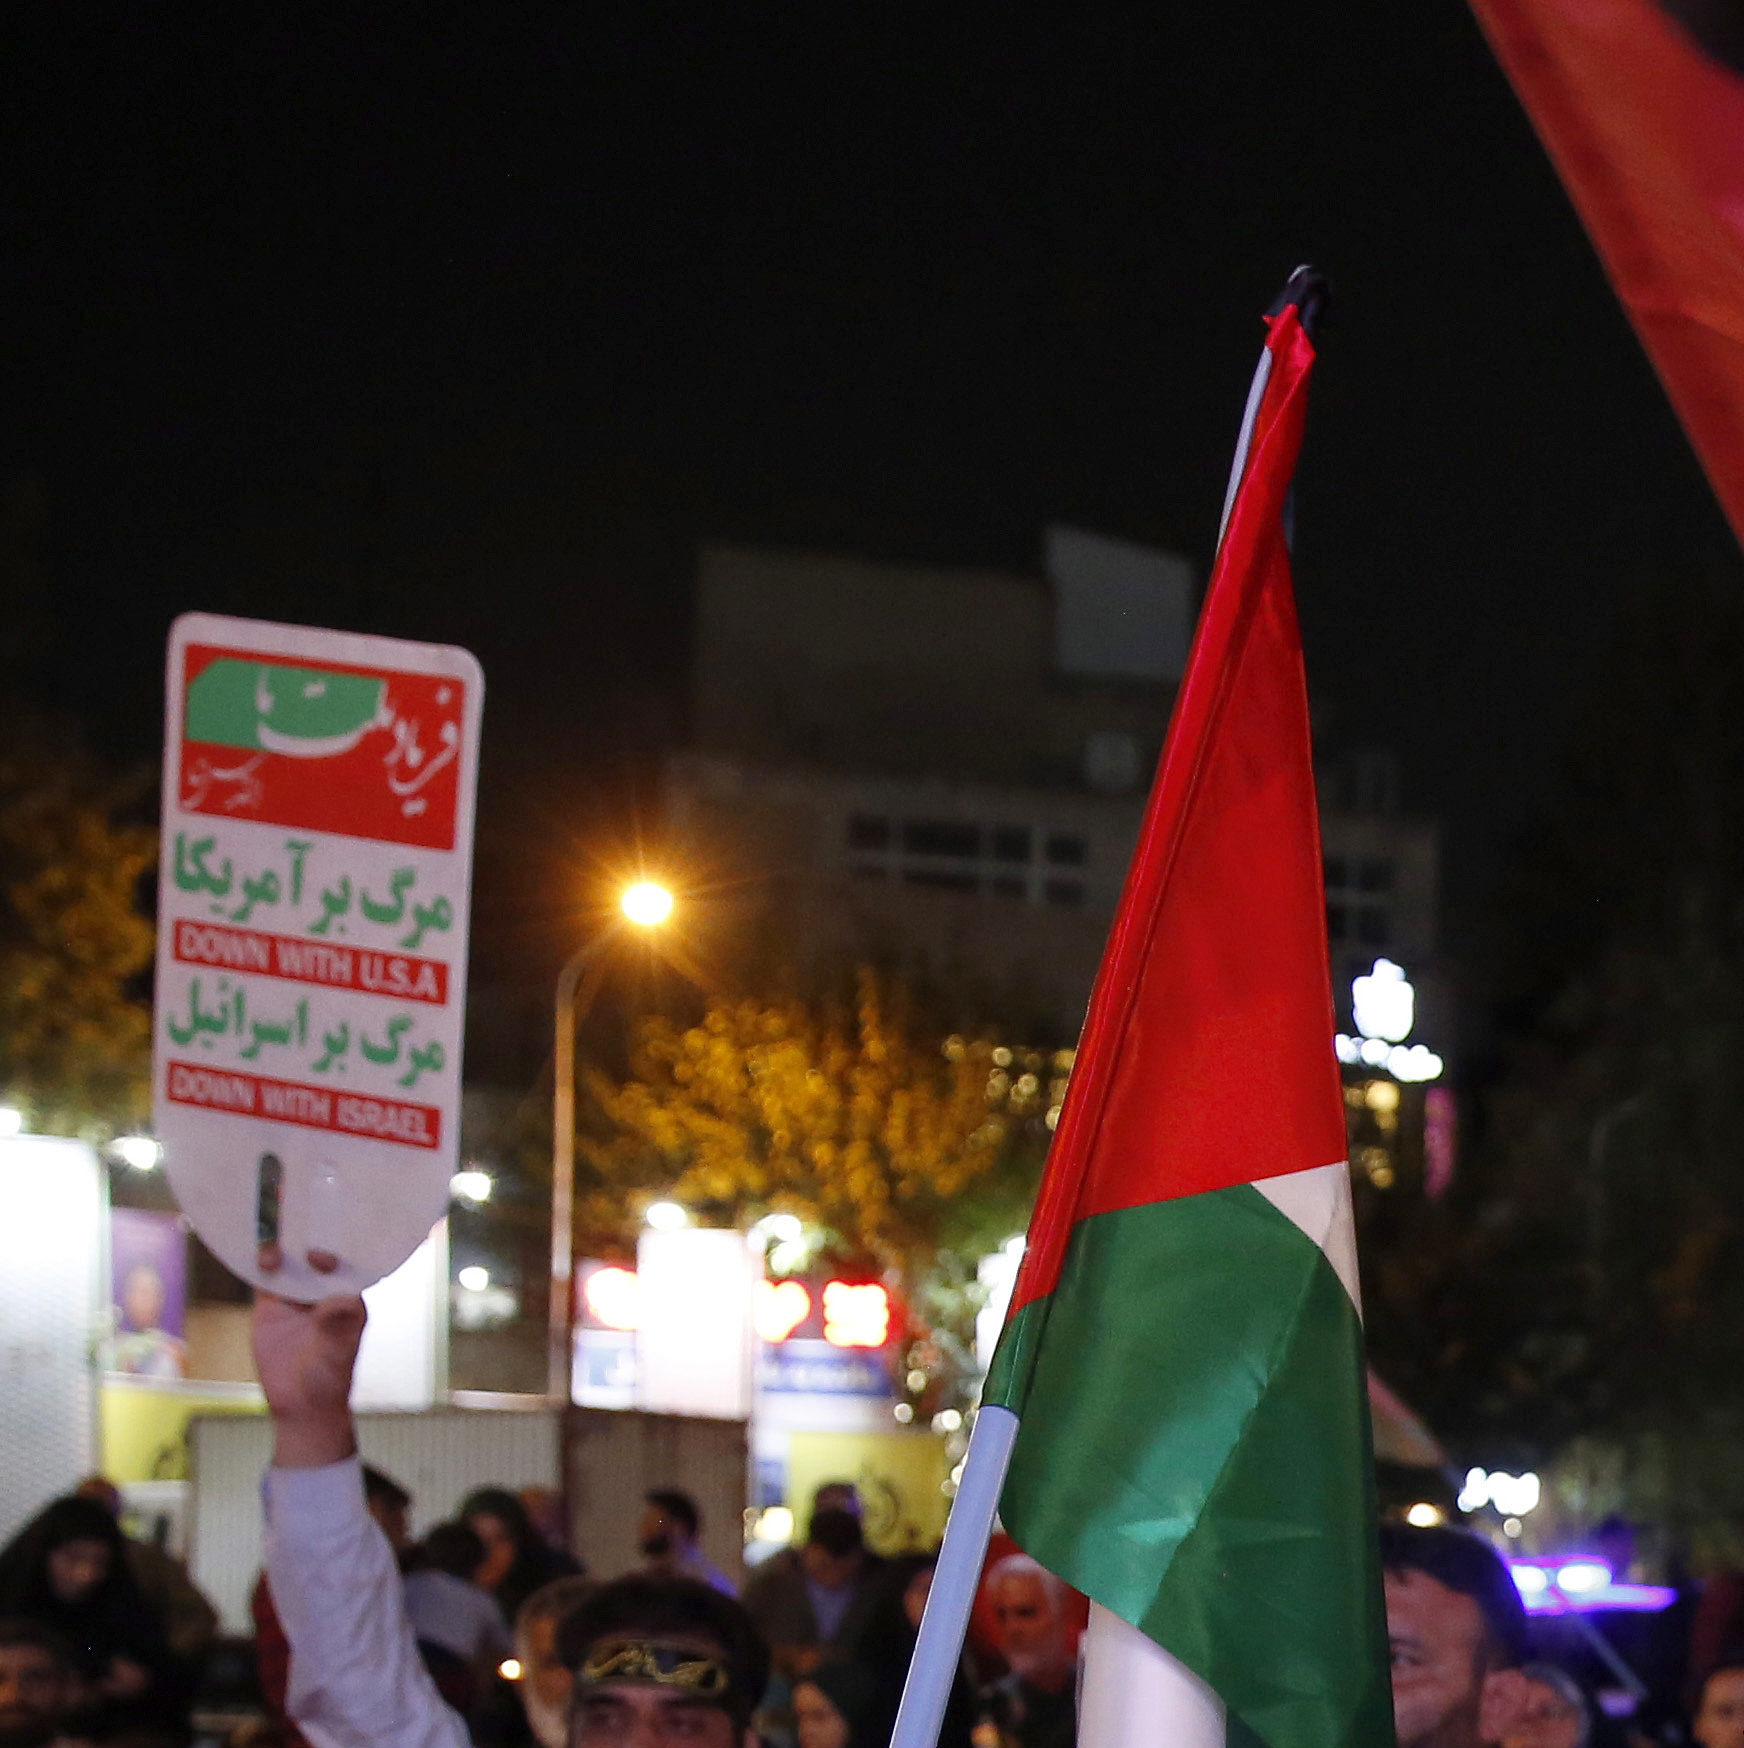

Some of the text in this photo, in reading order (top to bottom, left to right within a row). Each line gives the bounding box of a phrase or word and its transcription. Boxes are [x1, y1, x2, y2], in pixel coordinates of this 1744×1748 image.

[173, 832, 453, 947] مرگ بر آمریکا
[180, 925, 269, 969] DOWN
[277, 941, 352, 984] WITH
[167, 979, 443, 1086] مرگ بر اسرائیل
[172, 1067, 434, 1142] DOWN WITH ISRAEL
